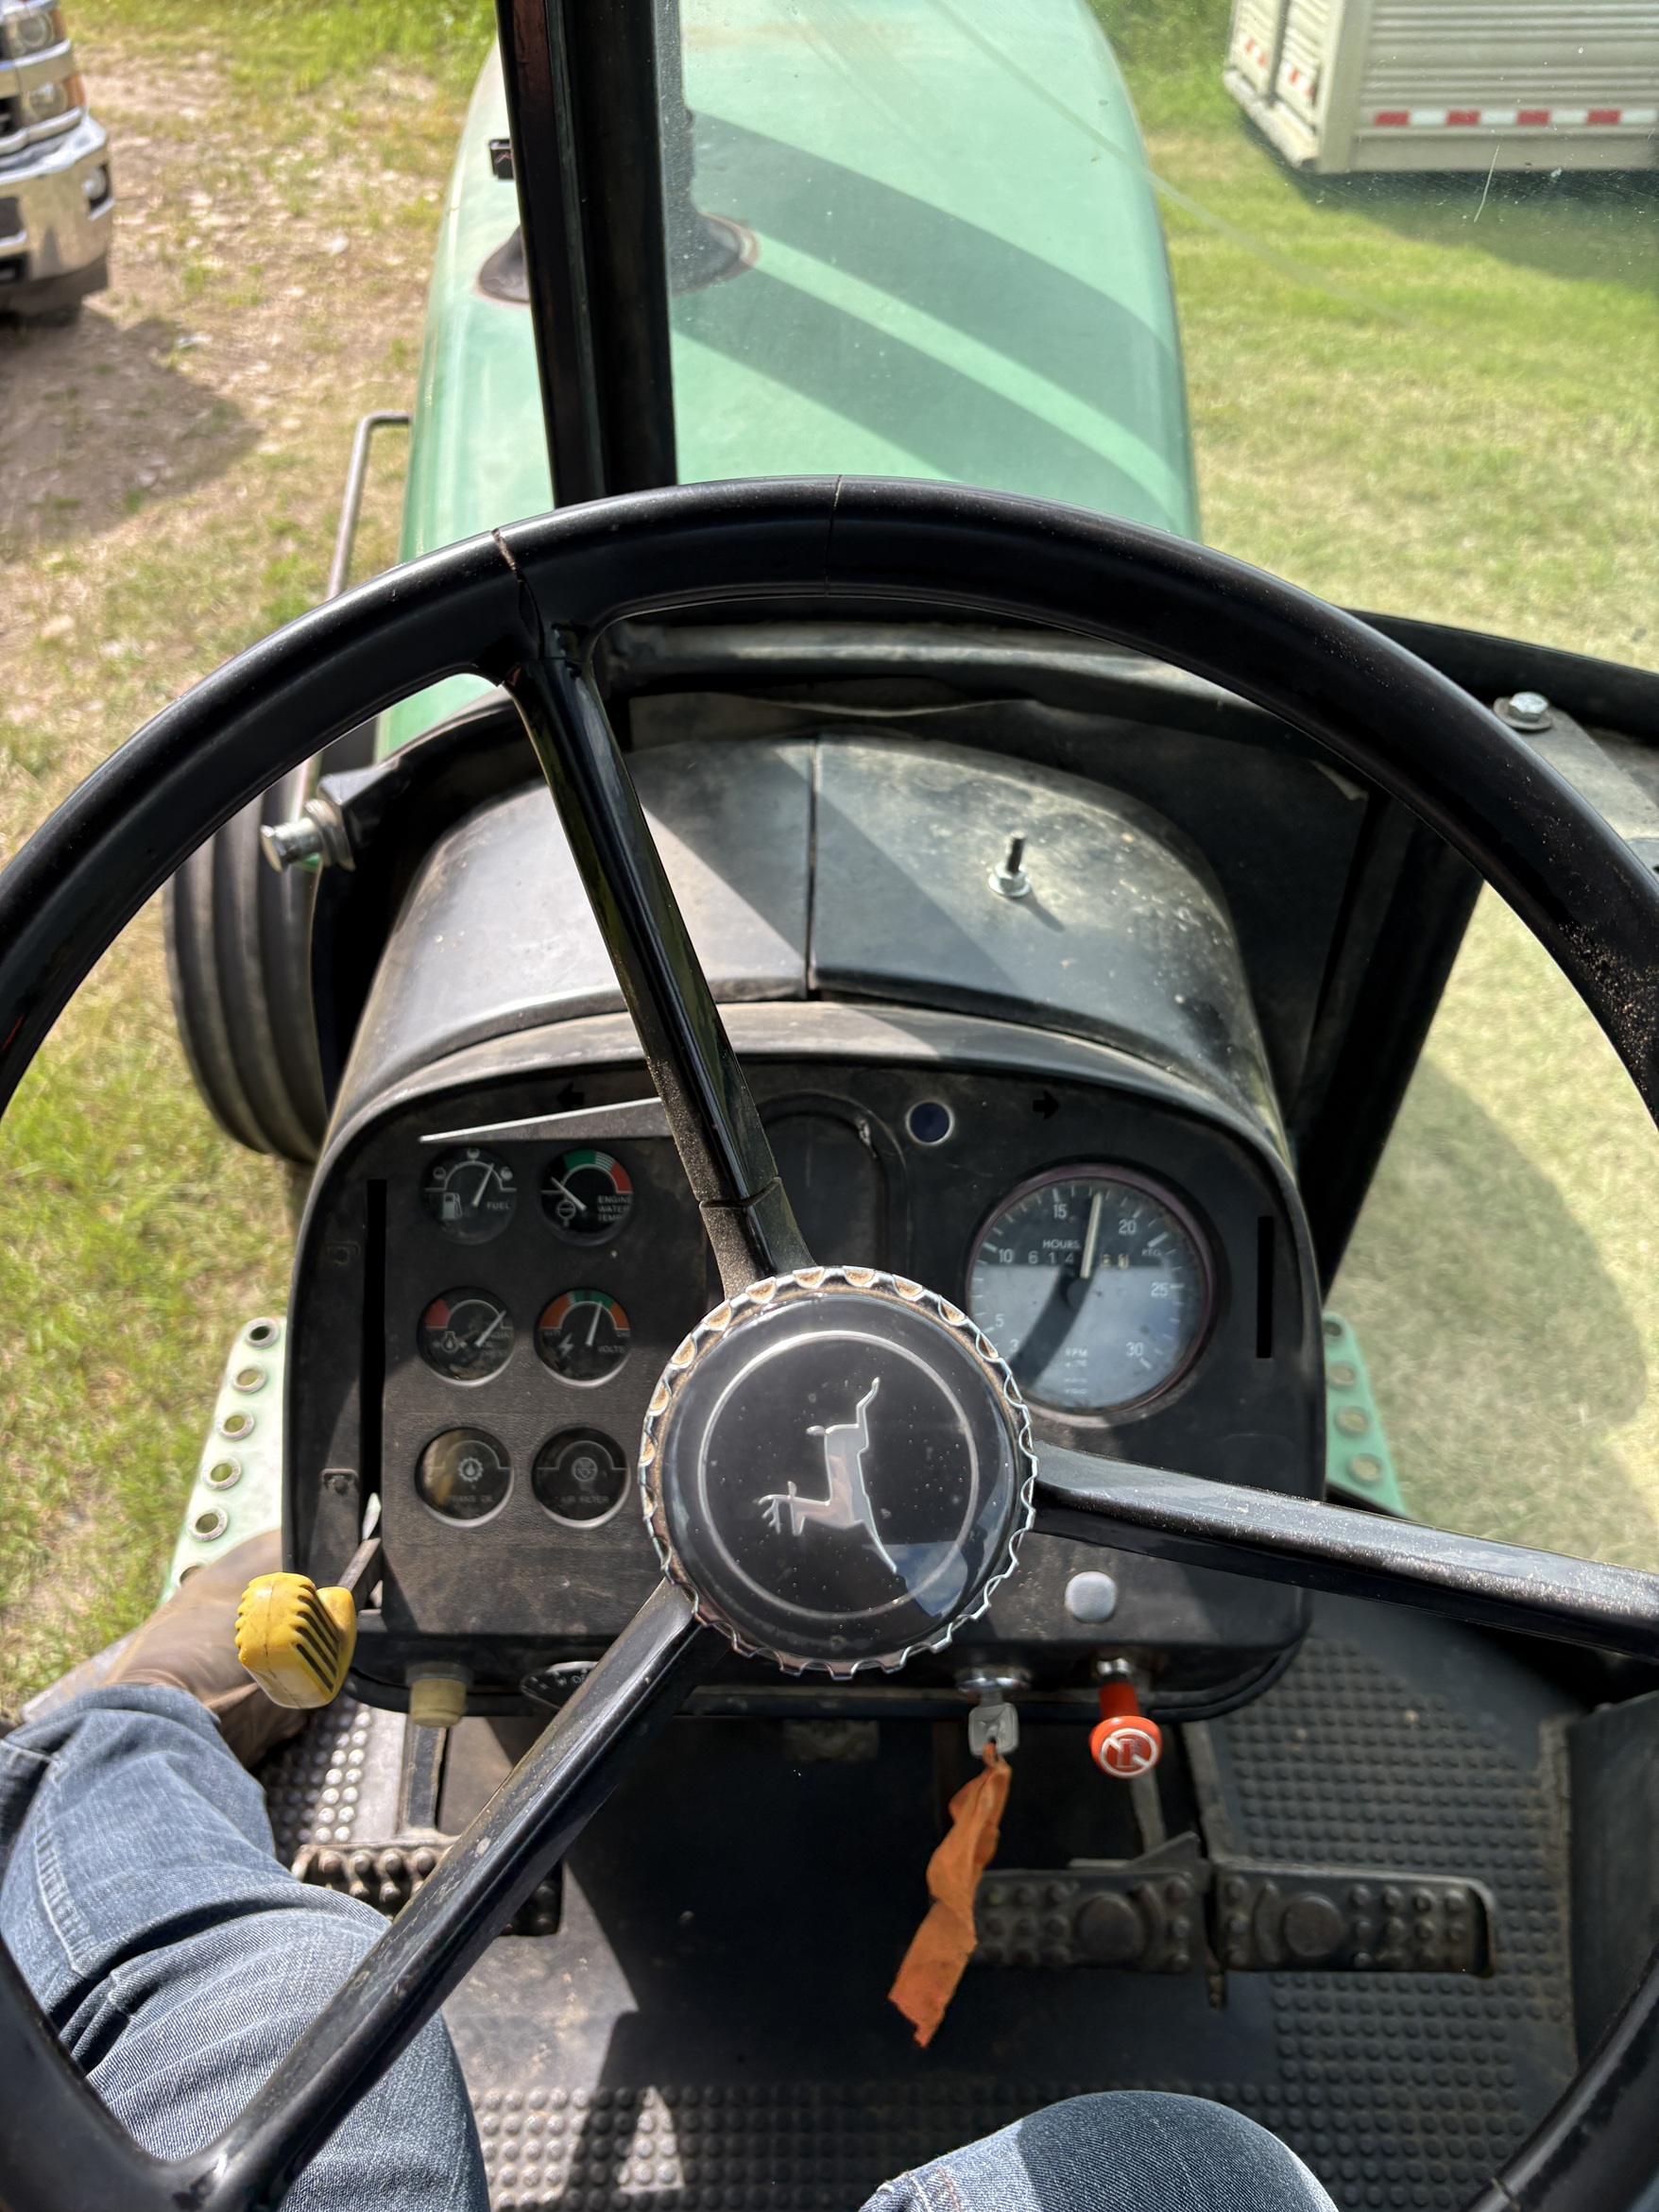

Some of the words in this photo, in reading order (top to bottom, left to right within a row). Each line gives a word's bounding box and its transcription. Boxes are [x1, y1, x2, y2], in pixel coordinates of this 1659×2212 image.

[487, 1201, 510, 1210] FUEL
[1053, 1204, 1068, 1219] 15
[1118, 1219, 1137, 1235] 20
[1042, 1239, 1081, 1248] HOURS
[999, 1249, 1014, 1263] 10
[1151, 1282, 1169, 1297] 25
[995, 1314, 1004, 1328] 5
[597, 1345, 625, 1353] VOLTS
[1065, 1348, 1087, 1358] RPM
[1125, 1342, 1144, 1357] 30
